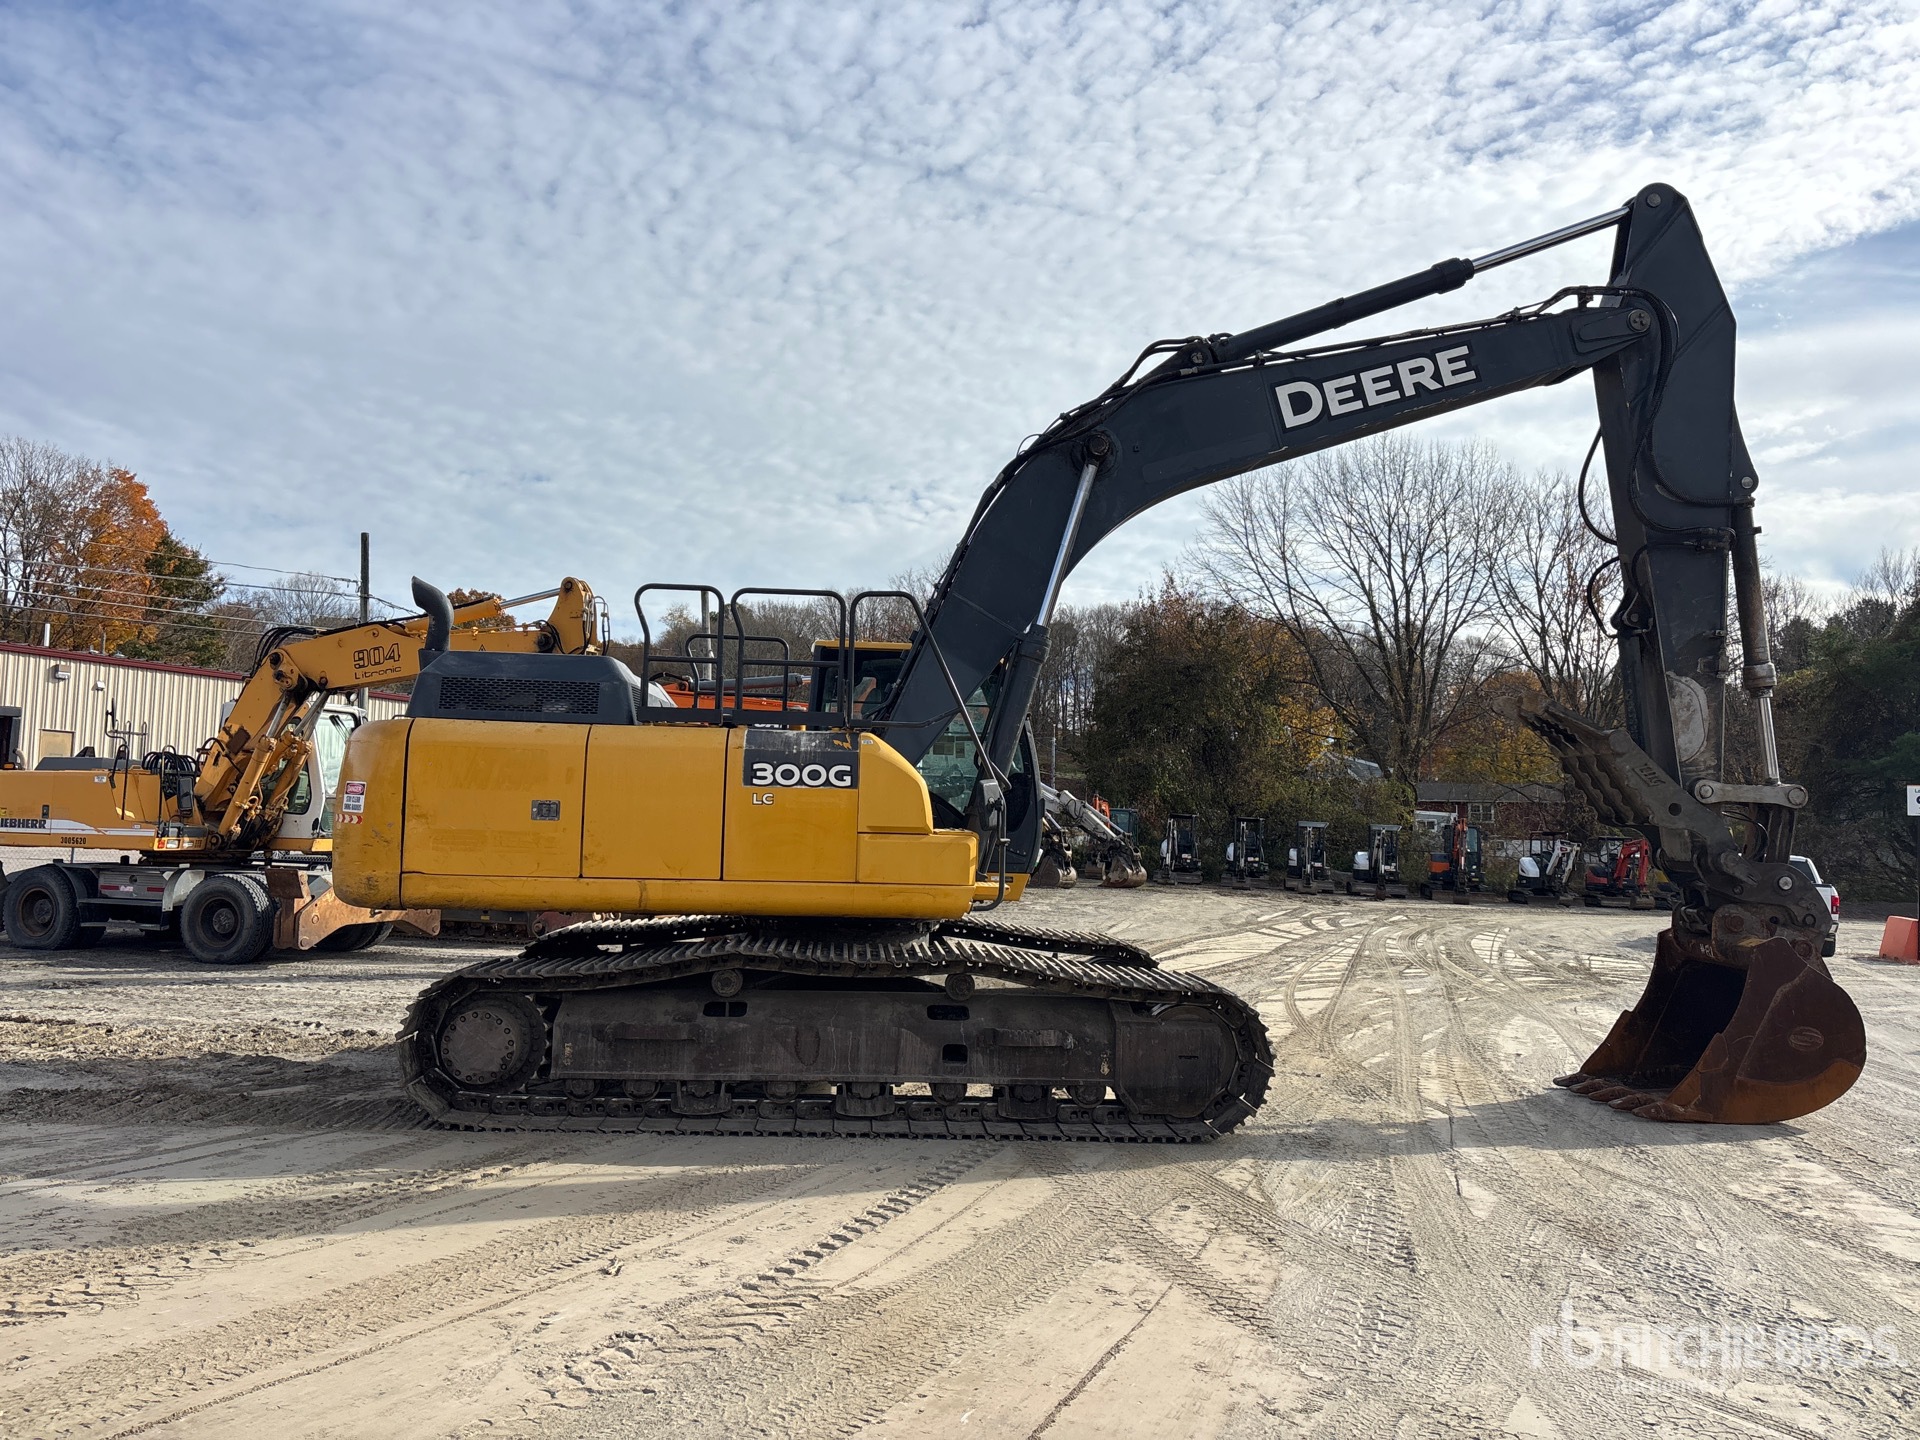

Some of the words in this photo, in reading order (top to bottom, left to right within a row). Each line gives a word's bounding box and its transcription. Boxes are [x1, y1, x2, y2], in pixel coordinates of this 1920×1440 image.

[1275, 345, 1477, 428] DEERE
[353, 643, 401, 669] 904
[354, 666, 402, 680] Litronic
[751, 762, 853, 787] 300G
[752, 793, 774, 805] LC
[0, 818, 47, 829] IEBHERR
